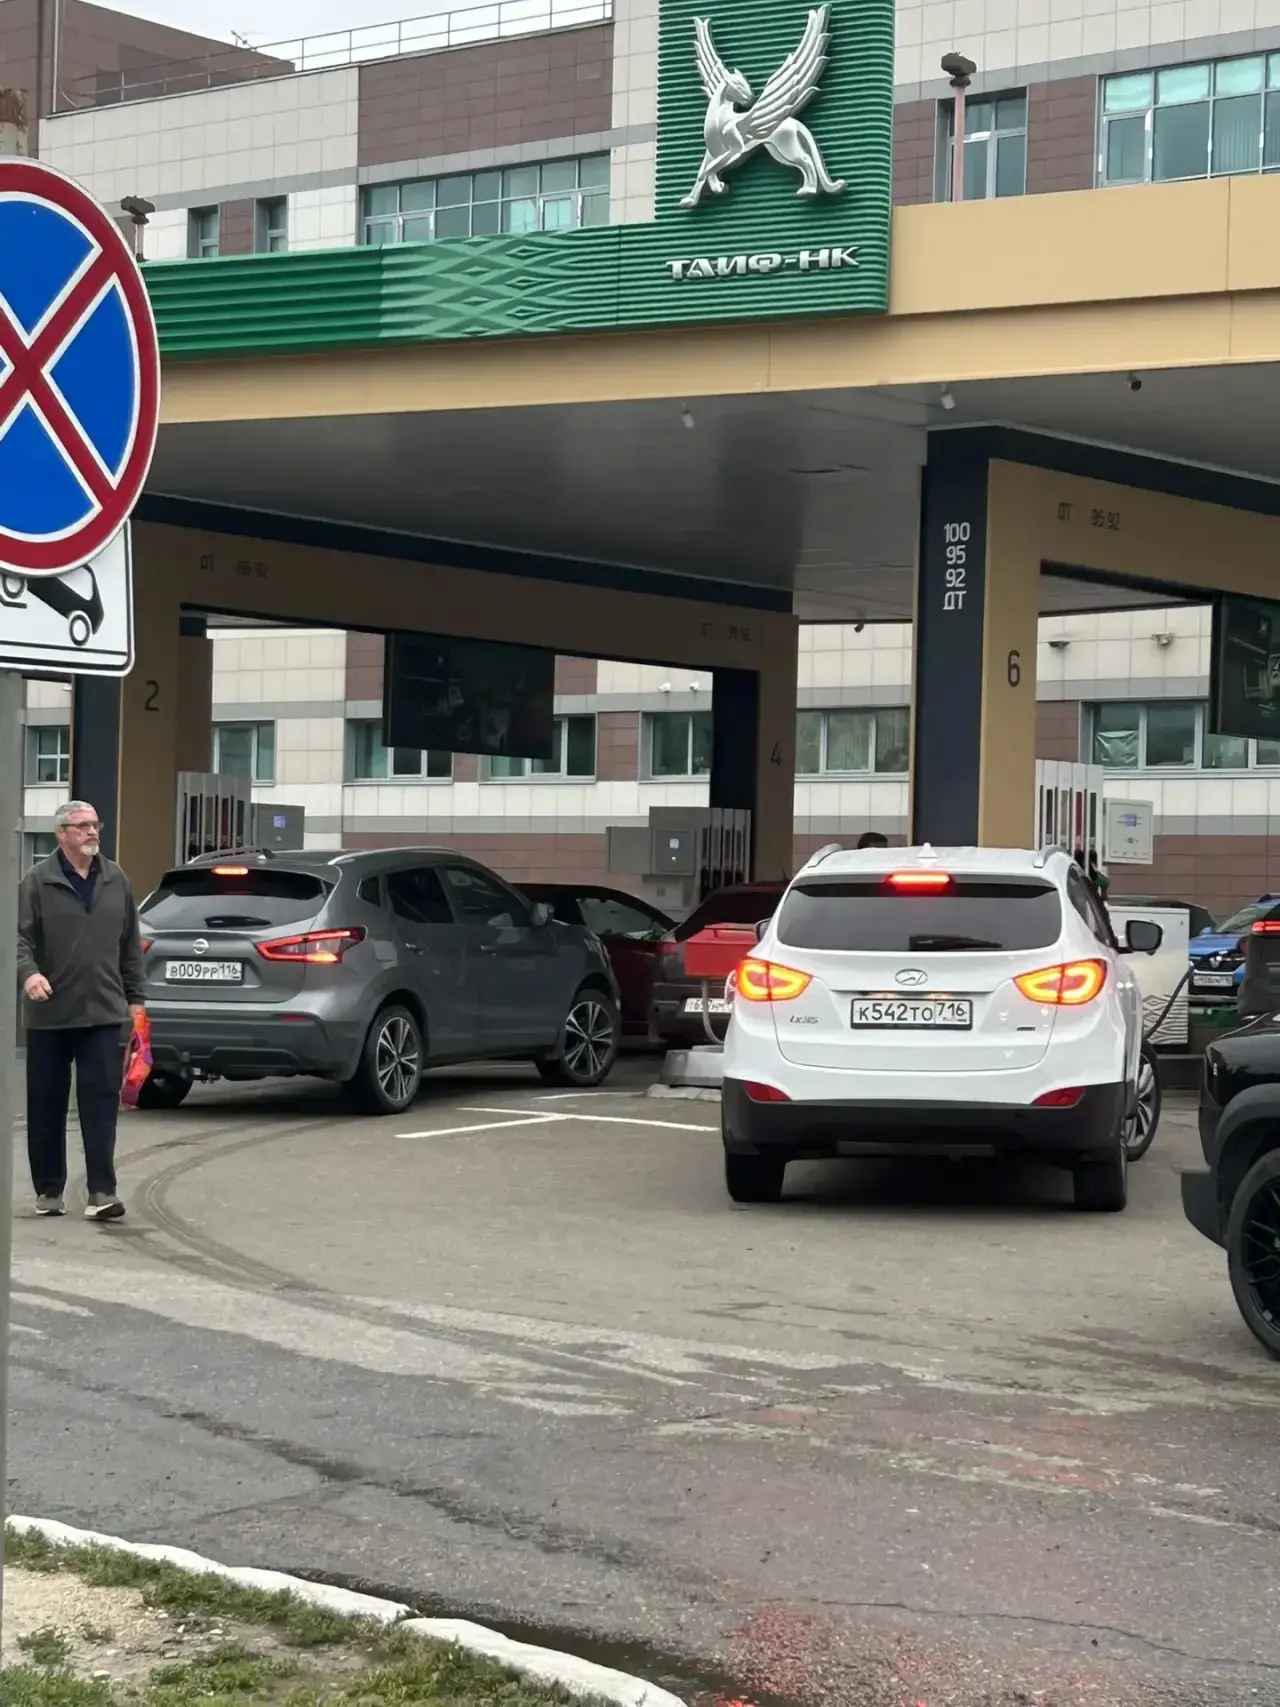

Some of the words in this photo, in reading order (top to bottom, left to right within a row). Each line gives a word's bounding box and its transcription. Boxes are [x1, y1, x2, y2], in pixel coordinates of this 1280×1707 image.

[665, 246, 860, 279] ТАИФ-НК
[944, 521, 971, 543] 100
[946, 544, 966, 565] 95
[945, 567, 966, 588] 92
[942, 590, 967, 610] ДТ
[1007, 649, 1021, 687] 6
[145, 679, 160, 712] 2
[769, 741, 784, 767] 4
[859, 1002, 933, 1022] К542ТО
[936, 1002, 966, 1017] 716
